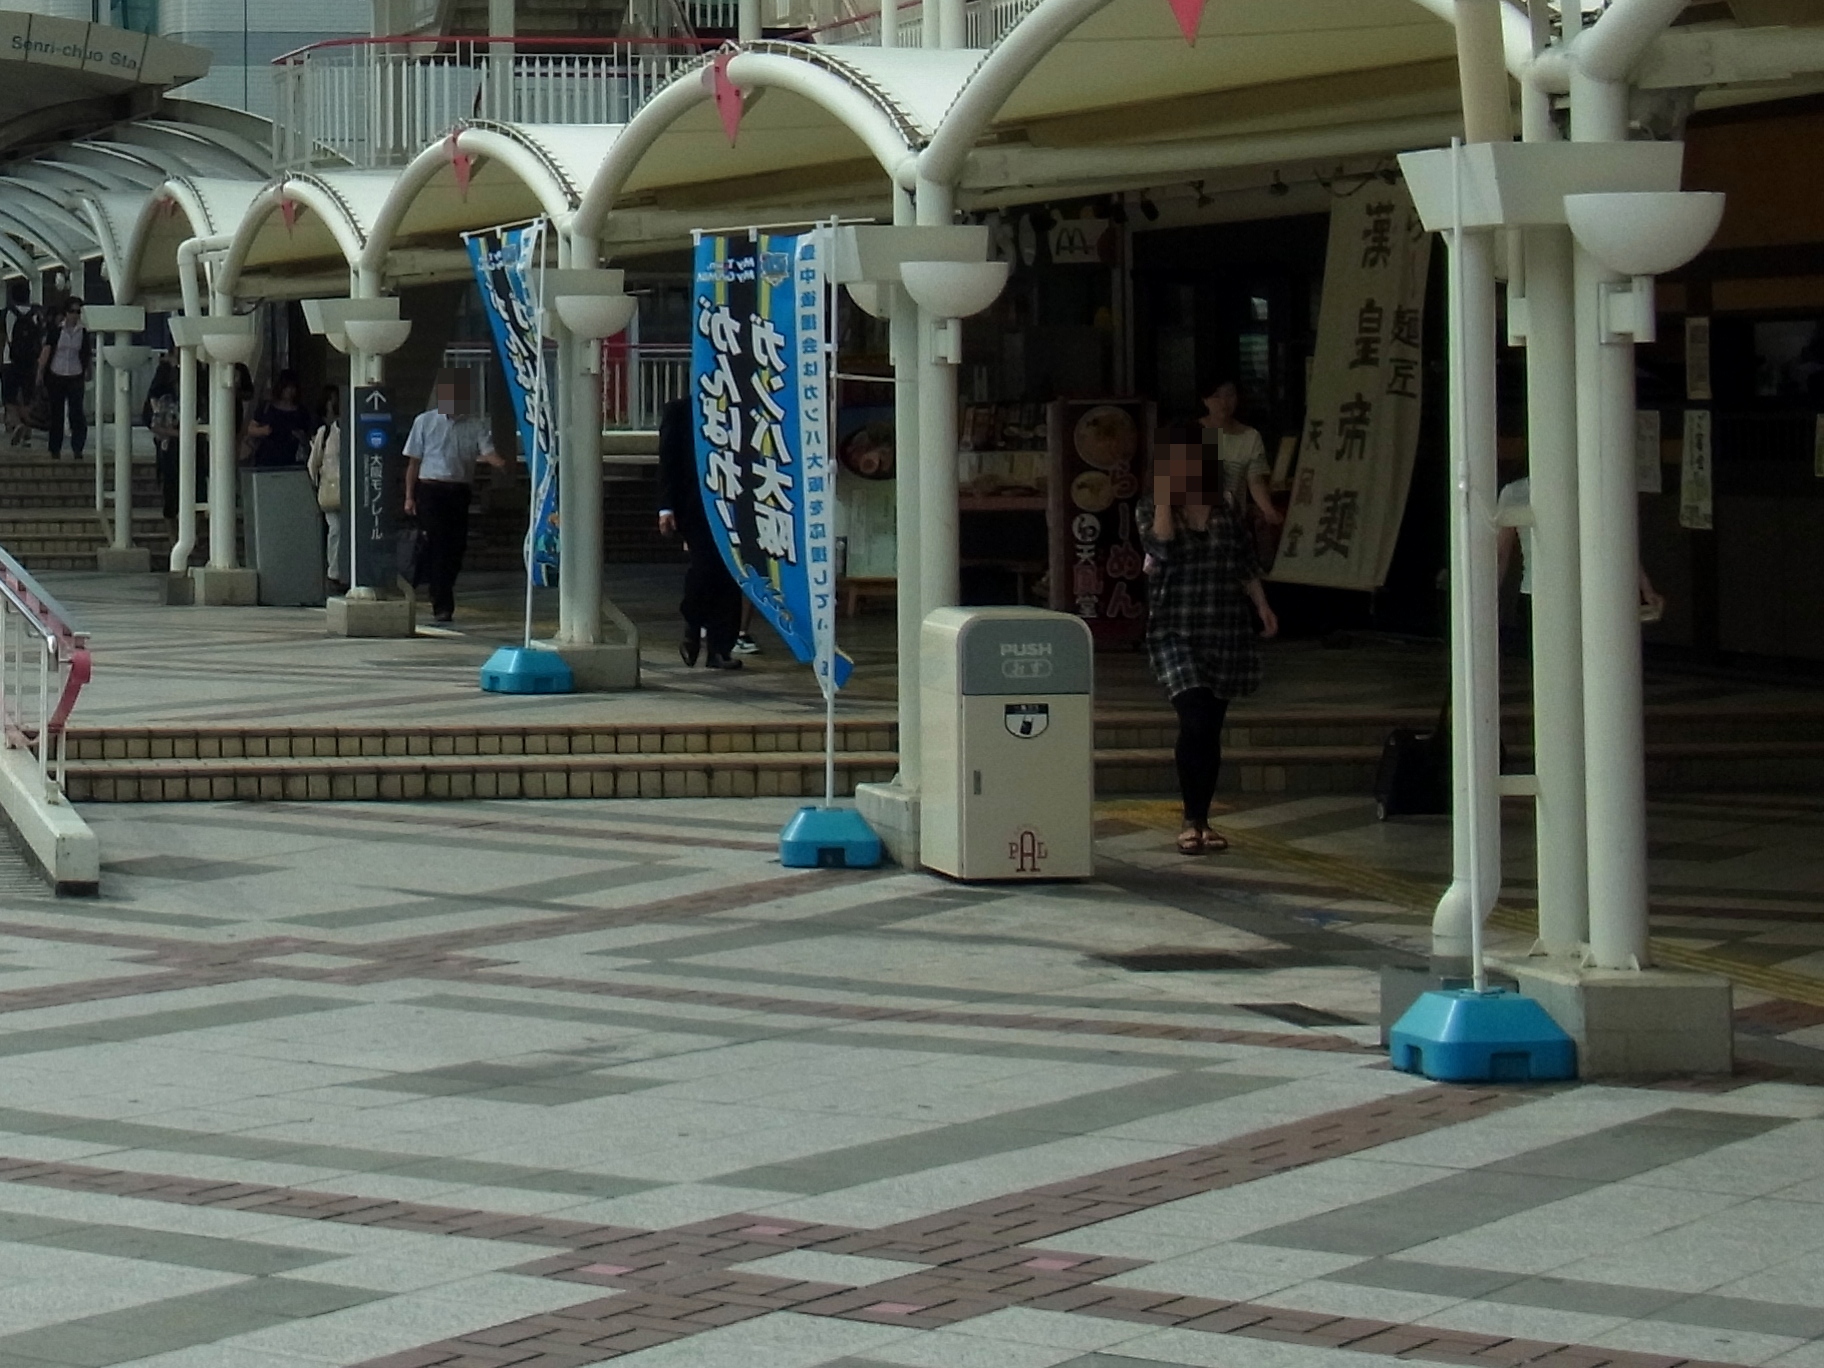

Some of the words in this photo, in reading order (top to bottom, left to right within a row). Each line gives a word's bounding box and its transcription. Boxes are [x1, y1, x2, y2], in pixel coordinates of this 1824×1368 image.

[11, 35, 104, 62] Senri-chuo
[370, 454, 384, 541] 大阪モノレール
[999, 642, 1053, 656] PUSH
[1008, 830, 1048, 872] PAL
